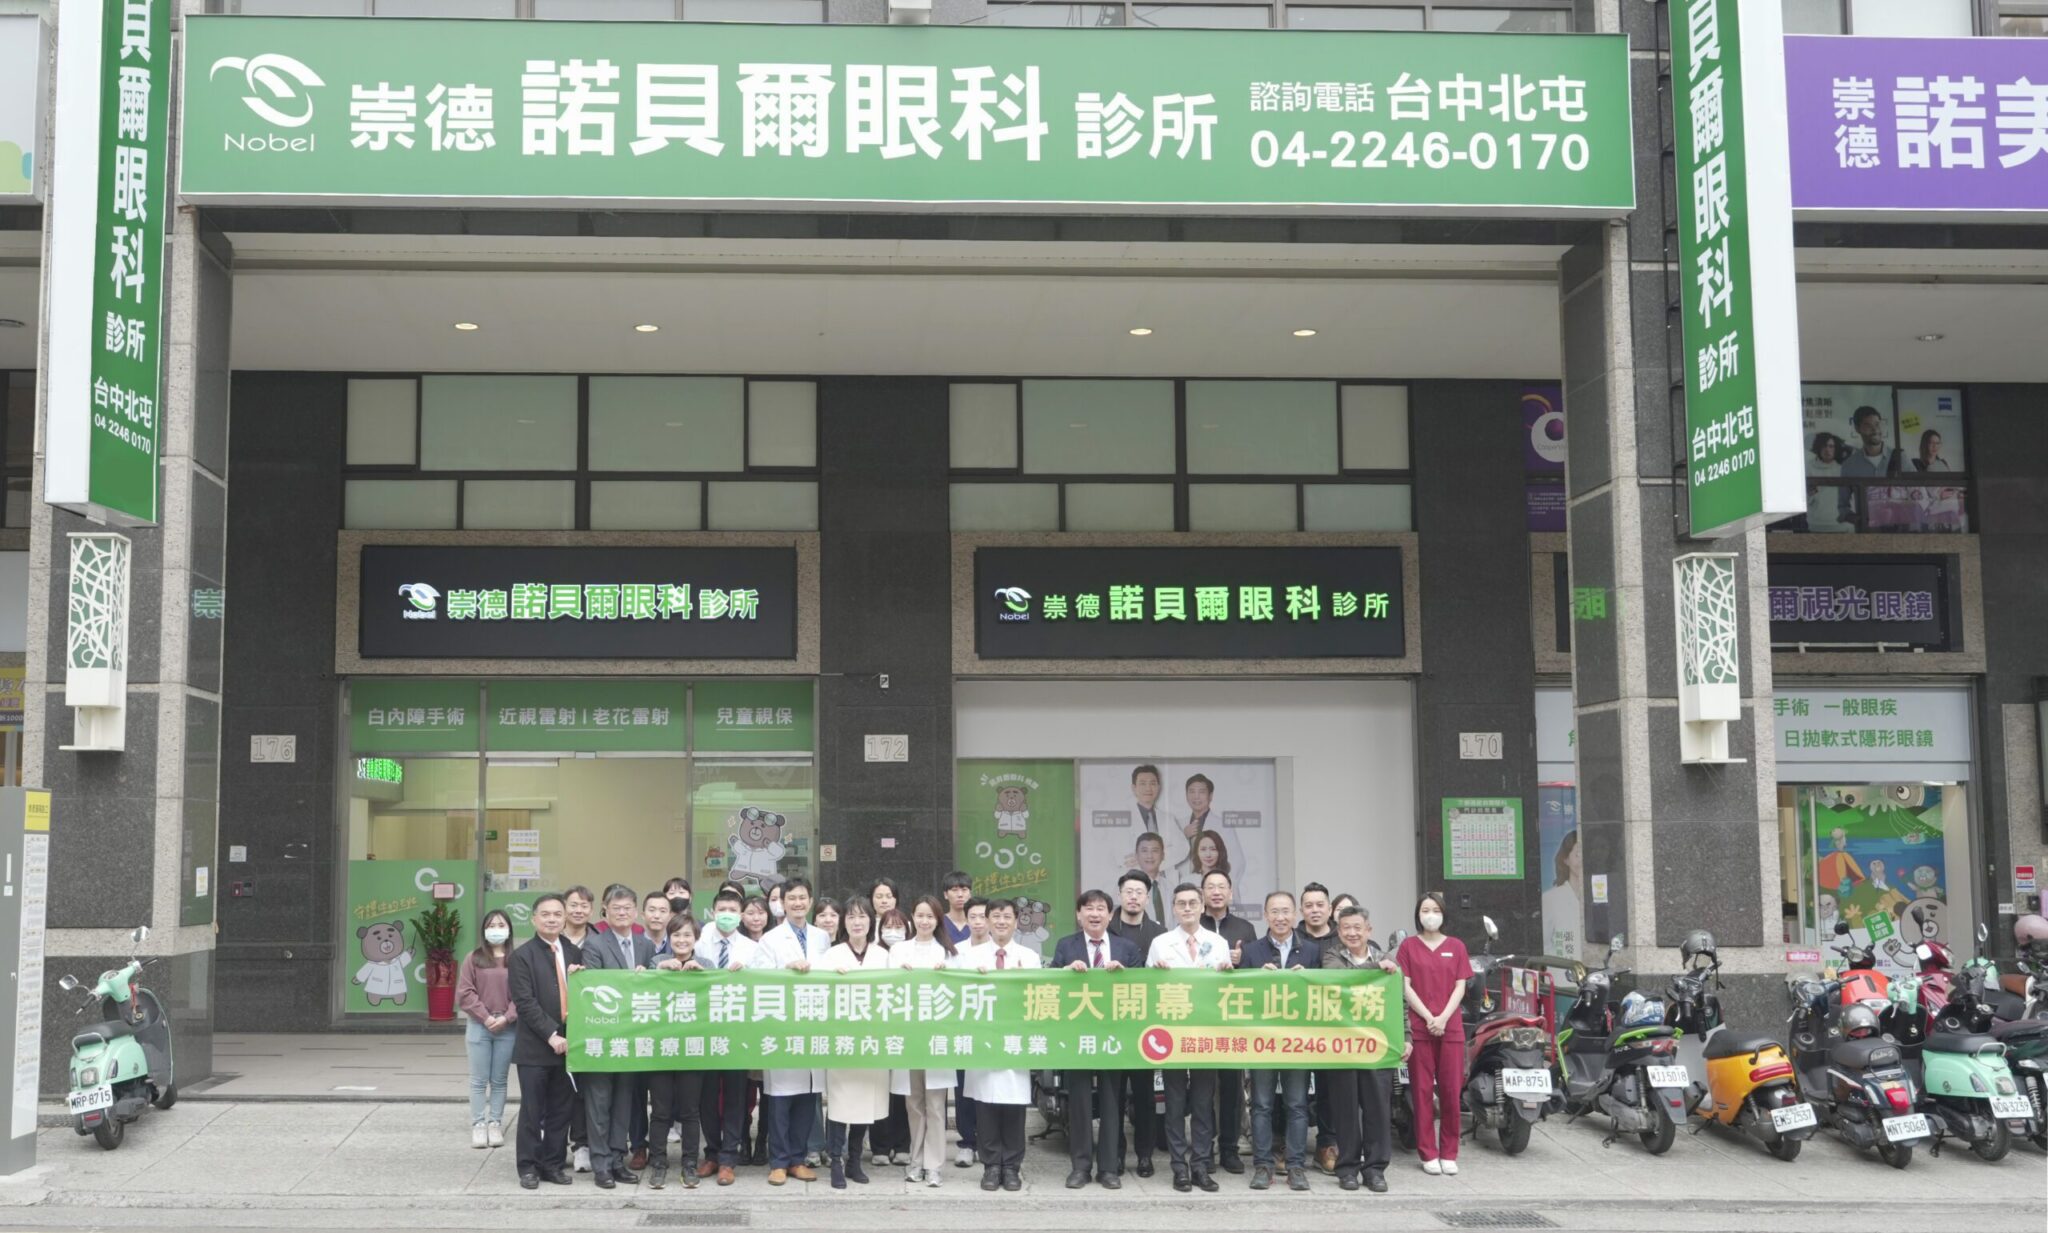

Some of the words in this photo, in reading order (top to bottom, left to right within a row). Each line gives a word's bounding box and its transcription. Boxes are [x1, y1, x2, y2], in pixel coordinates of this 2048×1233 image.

[1249, 81, 1375, 113] 諮詢電話
[1386, 72, 1588, 122] 台中北屯
[224, 133, 316, 153] Nobel
[1250, 129, 1590, 171] 04-2246-0170
[105, 311, 146, 362] 診所
[1698, 330, 1739, 393] 診所
[94, 376, 153, 429] 台中北屯
[94, 413, 106, 430] 04
[108, 419, 129, 444] 2246
[131, 432, 151, 455] 0170
[1692, 405, 1754, 462] 台中北屯
[1694, 469, 1706, 487] 04
[1708, 458, 1730, 482] 2246
[1731, 448, 1755, 472] 0170
[1000, 612, 1030, 620] Nobel
[368, 707, 465, 726] 白內障手術
[716, 706, 793, 726] 兒童視保
[1773, 698, 1809, 717] 手術
[1823, 698, 1898, 717] 一般眼疾
[253, 736, 294, 761] 176
[867, 737, 905, 760] 172
[1462, 735, 1498, 757] 170
[631, 991, 697, 1024] 崇德
[708, 983, 997, 1023] 諾貝爾眼科診所
[1023, 983, 1193, 1021] 擴大開幕
[1218, 983, 1386, 1022] 在此服務
[585, 1015, 620, 1025] Nobel
[1180, 1036, 1248, 1054] 諮詢專線
[1254, 1037, 1276, 1054] 04
[1282, 1037, 1327, 1054] 2246
[1332, 1038, 1377, 1054] 0170
[1505, 1075, 1549, 1088] MAP-8751
